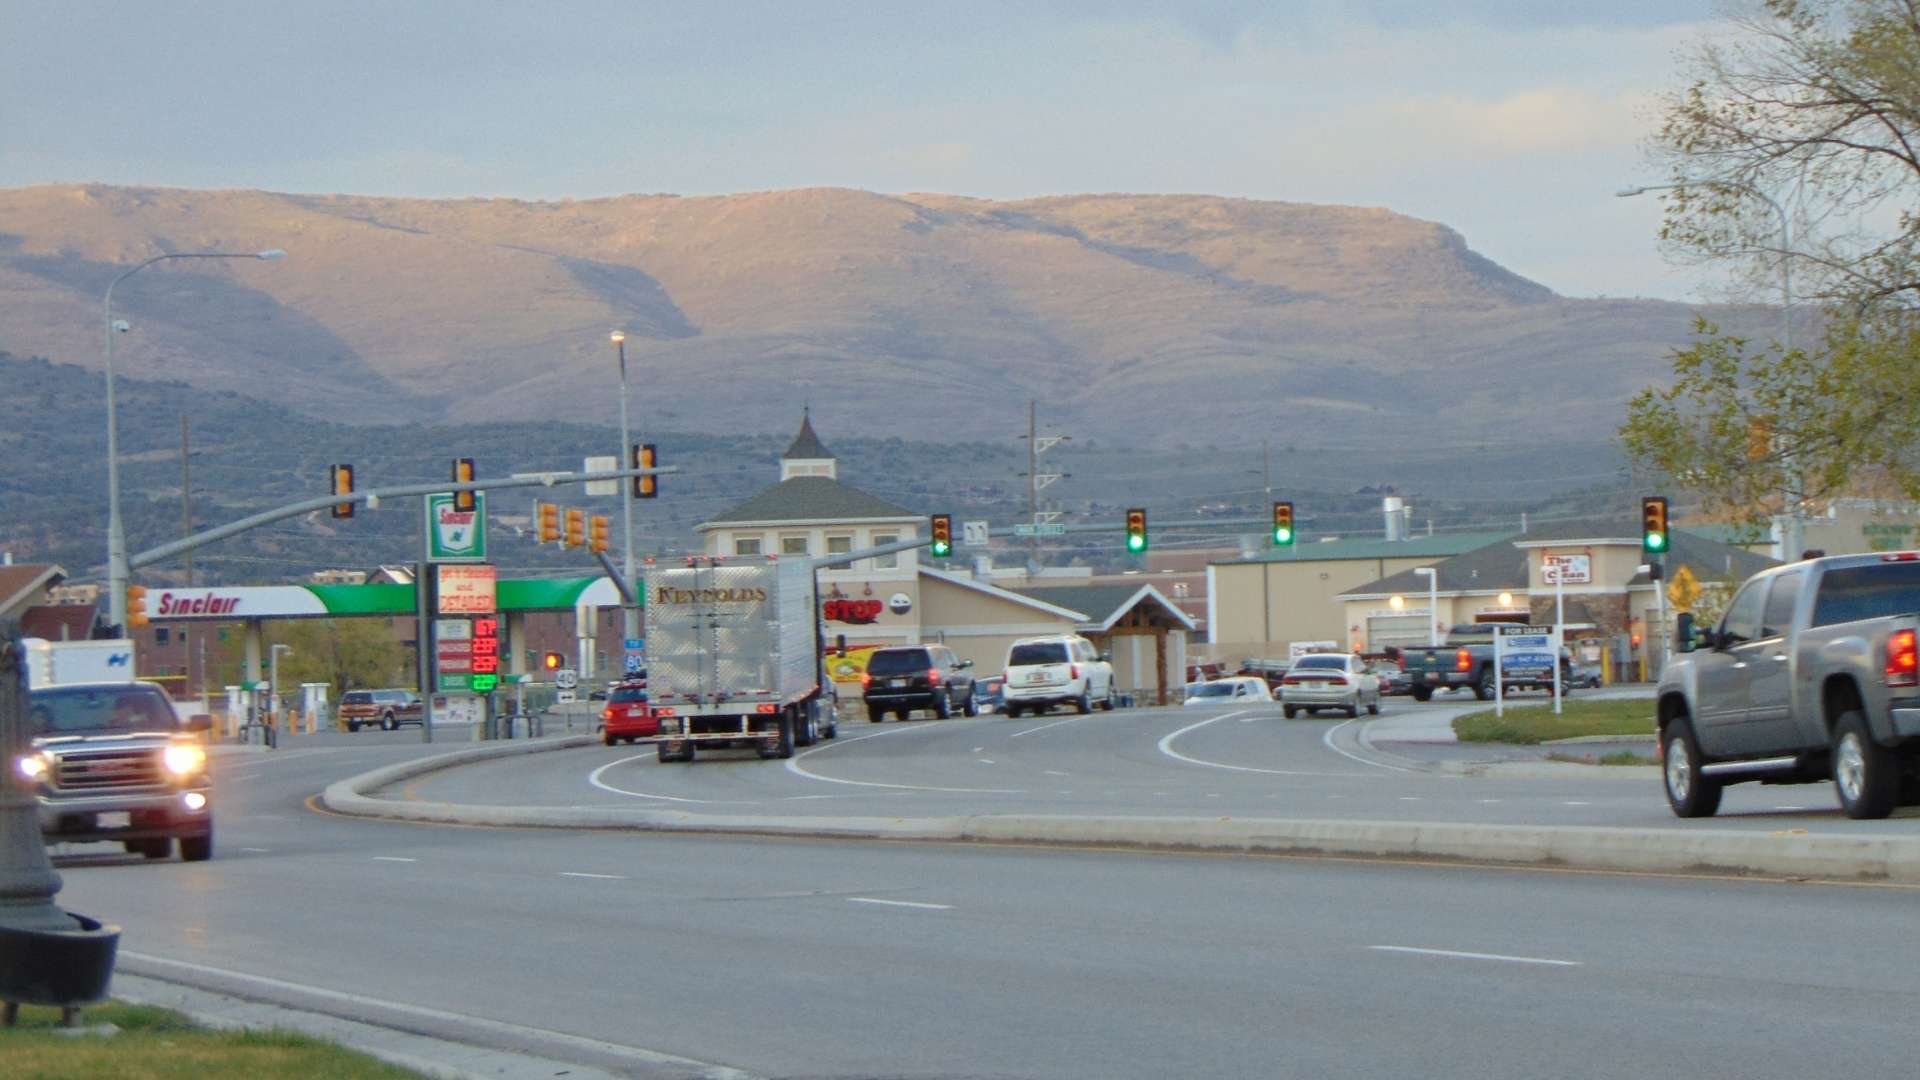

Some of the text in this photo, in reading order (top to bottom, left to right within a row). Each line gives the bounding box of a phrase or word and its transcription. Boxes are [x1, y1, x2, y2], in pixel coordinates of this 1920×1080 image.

[159, 592, 241, 614] Sinclair
[824, 600, 883, 621] STOP
[626, 655, 642, 667] 80
[559, 672, 574, 684] 40
